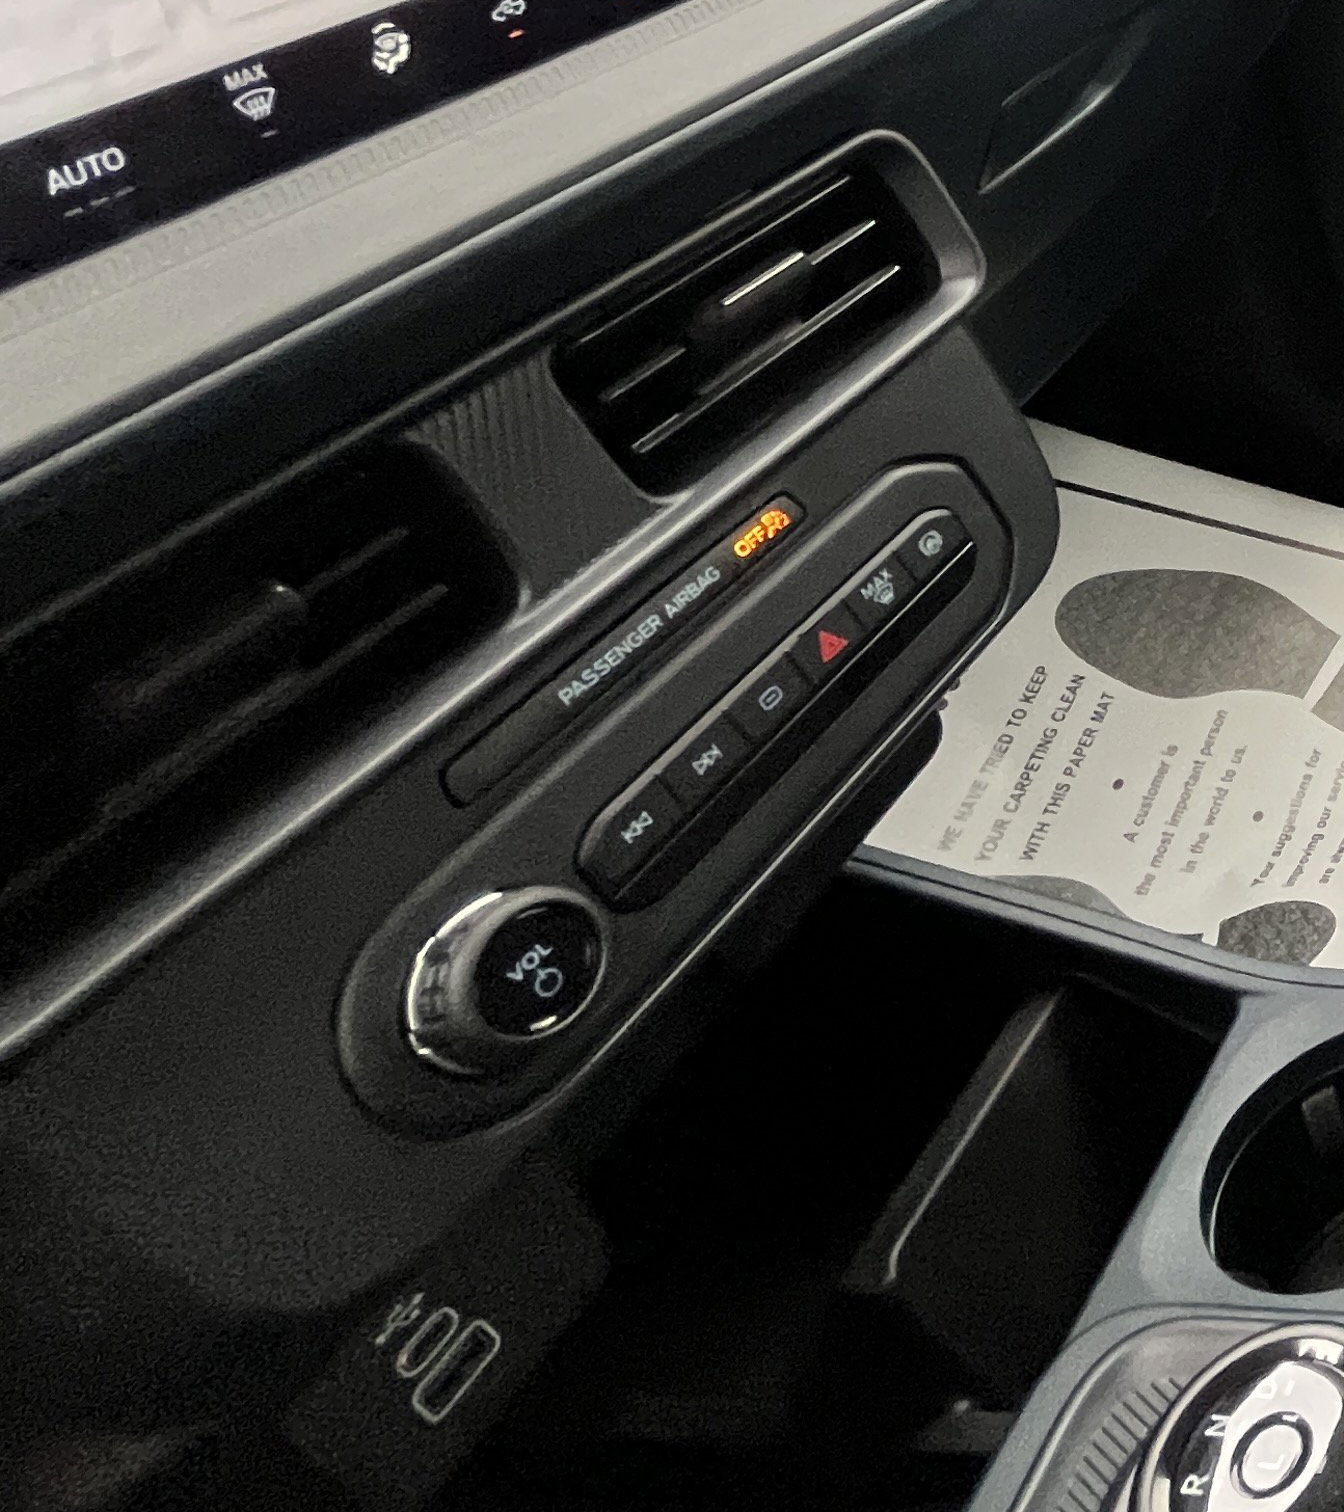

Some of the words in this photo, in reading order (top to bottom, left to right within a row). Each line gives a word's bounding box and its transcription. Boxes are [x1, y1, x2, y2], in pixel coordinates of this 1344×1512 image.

[223, 63, 268, 91] MAX
[47, 146, 126, 196] AUTO
[732, 525, 766, 558] OFF
[860, 568, 893, 600] MAX
[558, 614, 664, 707] PASSENGER
[663, 566, 721, 619] AIRBAG
[937, 825, 963, 852] WE
[953, 779, 989, 823] HAVE
[979, 733, 1014, 776] TRIED
[1005, 708, 1028, 728] TO
[1018, 665, 1049, 704] KEEP
[974, 818, 1013, 862] YOUR
[1003, 727, 1058, 814] CARPETING
[1051, 674, 1087, 723] CLEAN
[1019, 821, 1051, 861] WITH
[1042, 782, 1071, 816] THIS
[1063, 727, 1099, 778] PAPER
[1090, 691, 1116, 724] MAT
[1123, 831, 1140, 844] A
[1133, 759, 1170, 827] customer
[1160, 744, 1178, 757] is
[1134, 873, 1156, 896] the
[1150, 830, 1175, 869] most
[1164, 760, 1207, 828] important
[1200, 709, 1229, 757] person
[1190, 831, 1210, 854] the
[1203, 786, 1229, 826] world
[1220, 769, 1236, 783] to
[1271, 773, 1313, 858] suggestions
[1304, 748, 1322, 768] for
[1316, 806, 1332, 829] our
[505, 944, 553, 981] VOL
[1204, 1413, 1232, 1438] N
[1180, 1472, 1210, 1496] R
